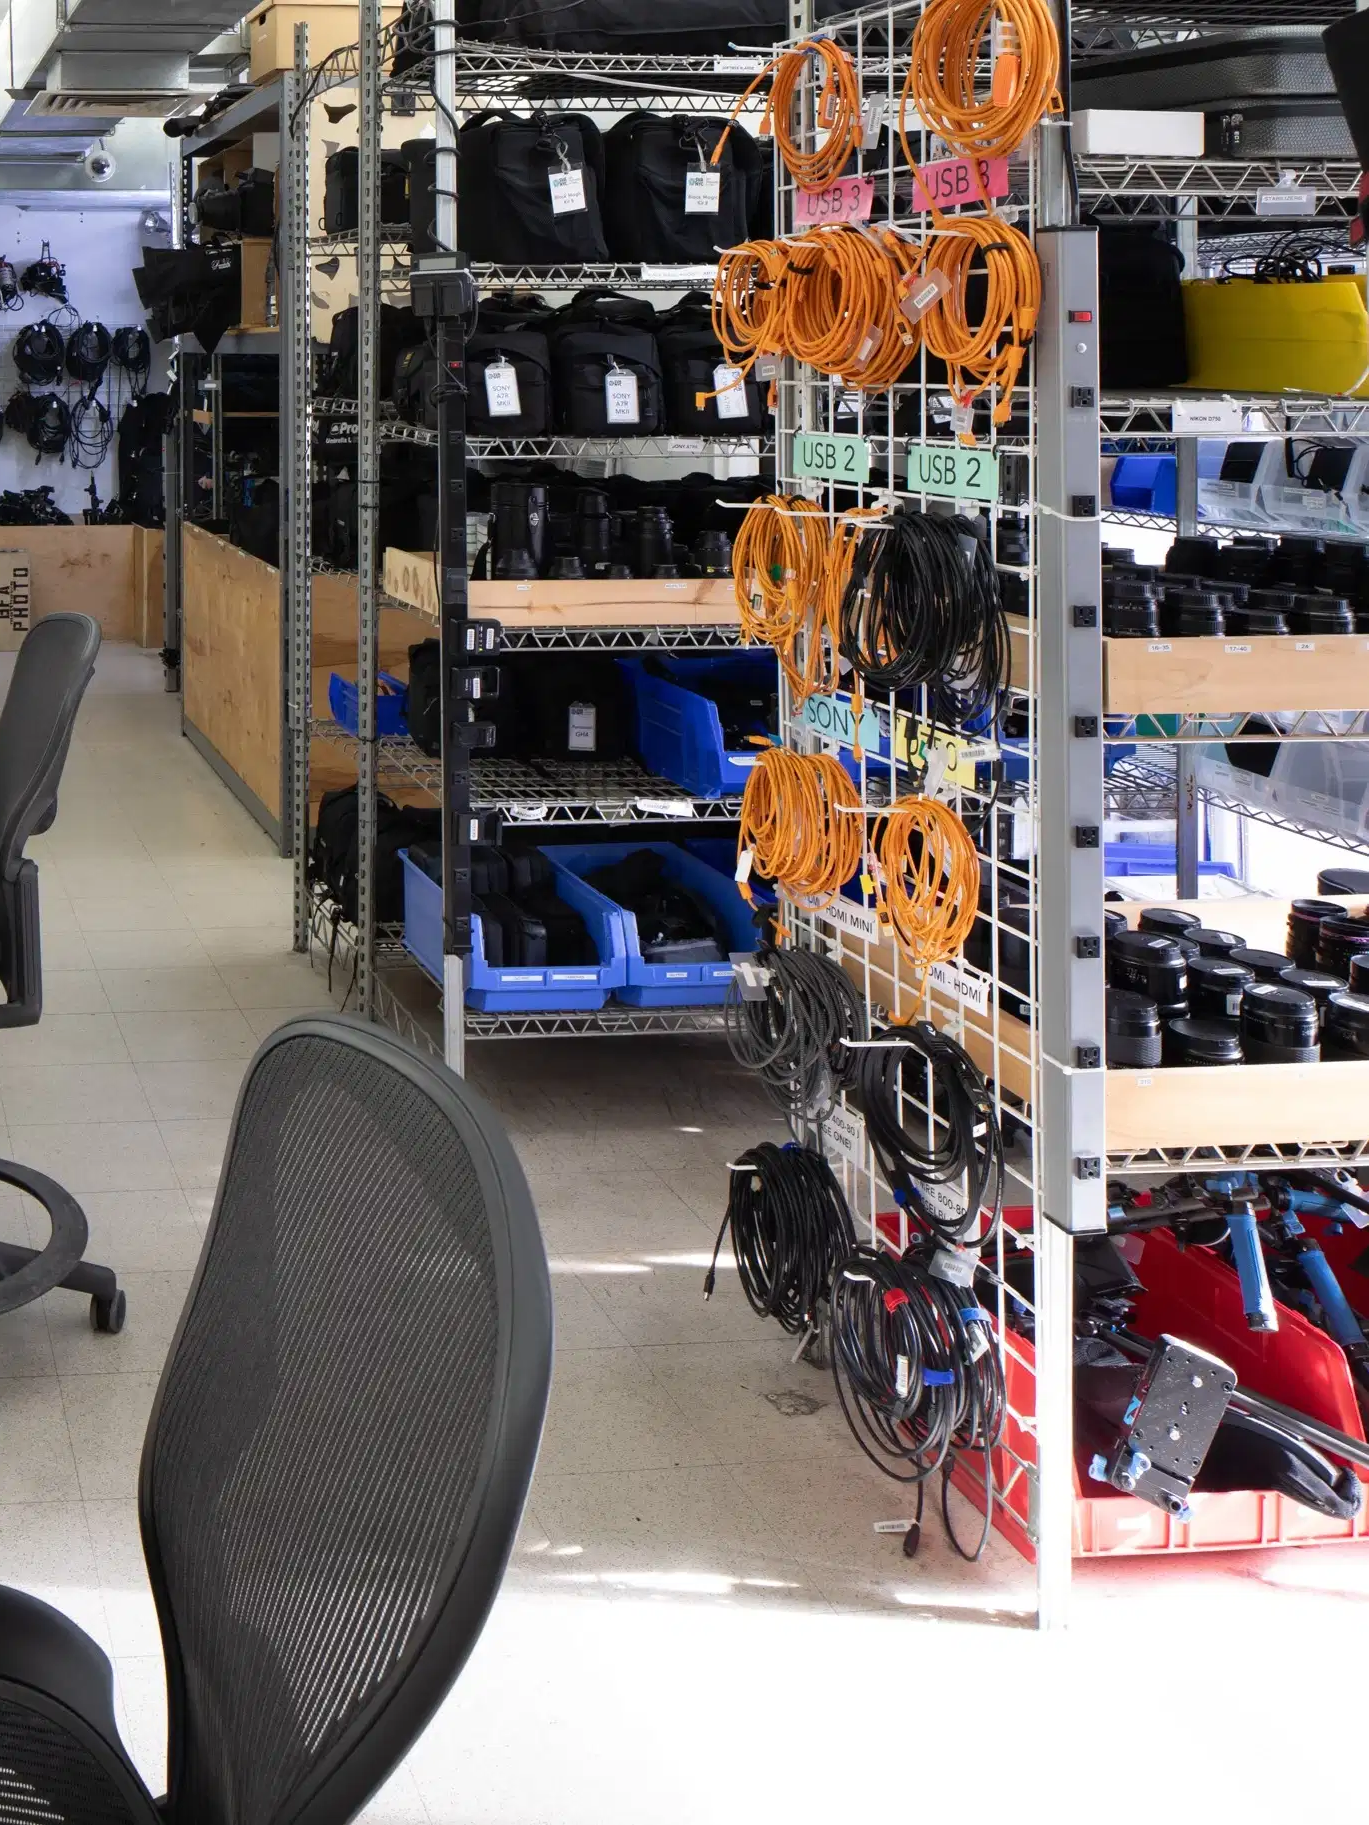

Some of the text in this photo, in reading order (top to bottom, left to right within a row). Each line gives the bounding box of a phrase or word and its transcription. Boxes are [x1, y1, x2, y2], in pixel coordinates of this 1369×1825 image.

[926, 164, 970, 201] USB
[807, 184, 861, 216] USB 3
[803, 441, 855, 472] USB 2
[919, 453, 981, 487] USB 2
[13, 568, 29, 631] PHOTO
[808, 696, 865, 736] SONY
[825, 907, 873, 935] HDMI MINI
[954, 980, 981, 1004] HDMI
[834, 1133, 852, 1151] ONE)
[937, 1193, 966, 1215] 800-80
